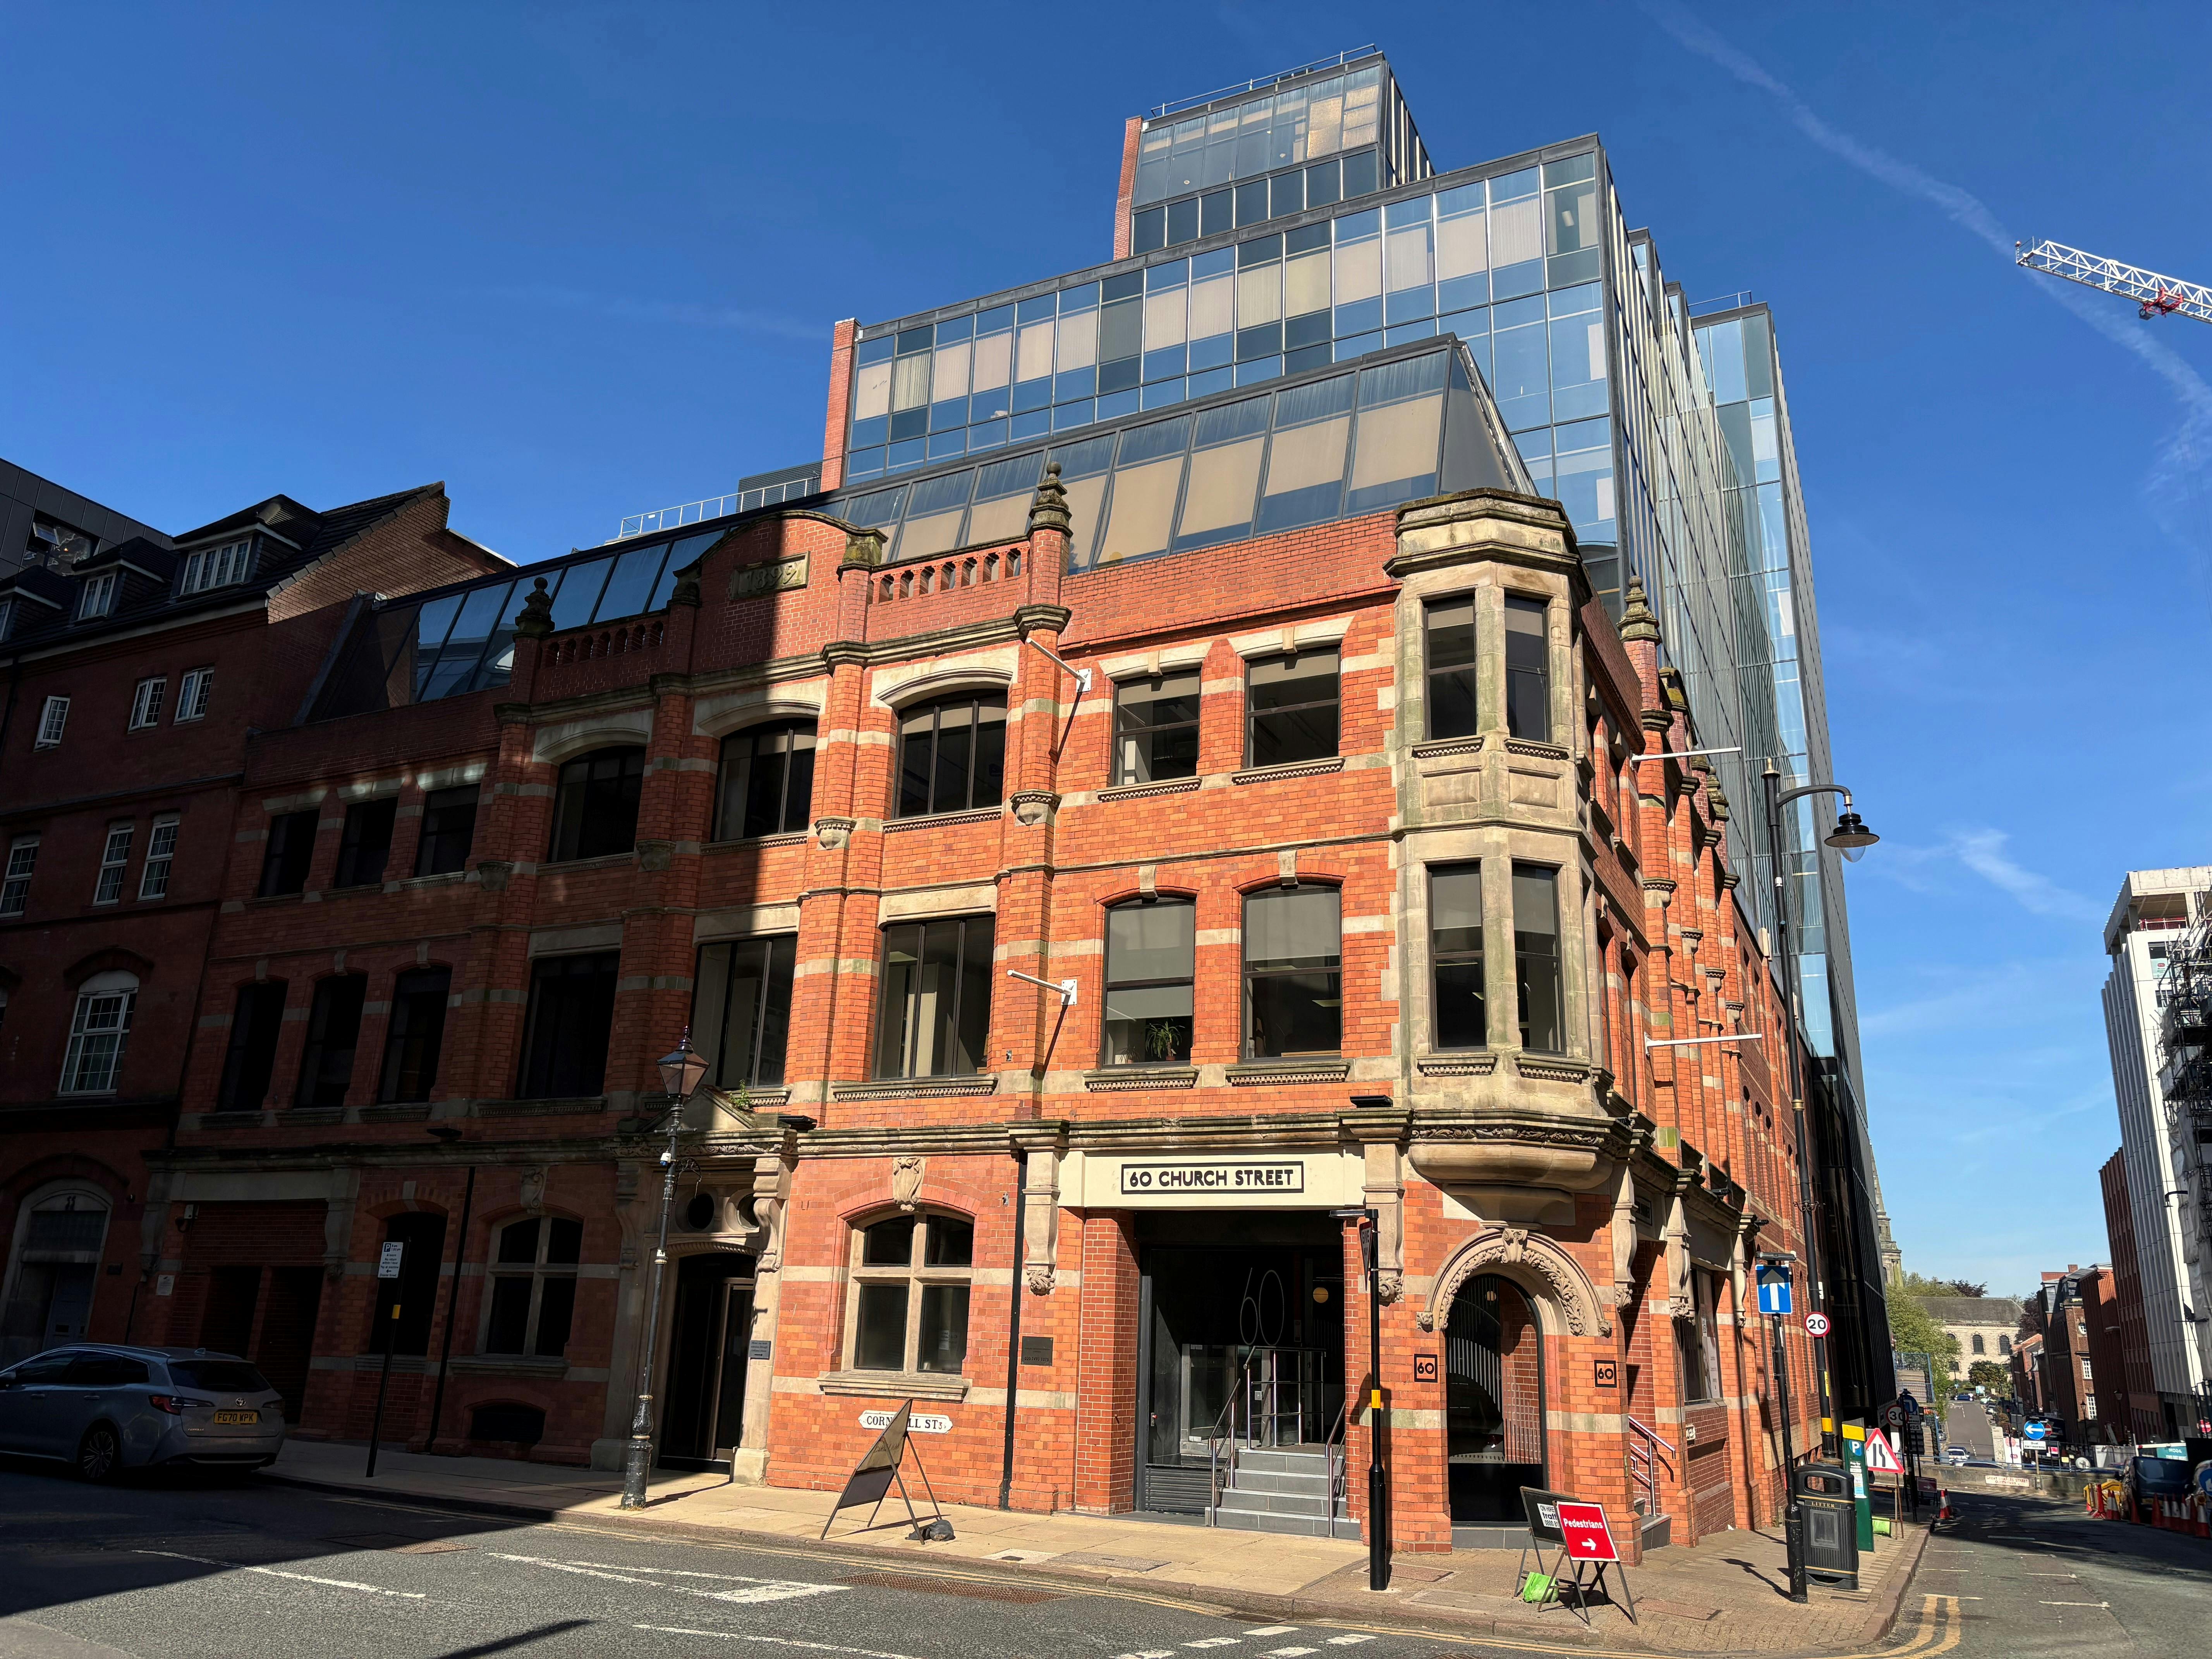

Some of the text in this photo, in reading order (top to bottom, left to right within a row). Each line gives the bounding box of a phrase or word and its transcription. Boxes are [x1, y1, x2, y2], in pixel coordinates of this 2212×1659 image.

[1129, 1169, 1293, 1187] 60 CHURCH STREET
[1240, 1267, 1284, 1346] 60
[1808, 1319, 1827, 1330] 20
[1417, 1362, 1434, 1374] 60
[1598, 1368, 1614, 1380] 60
[218, 1413, 237, 1421] FG70
[867, 1415, 921, 1428] CORNLL
[925, 1419, 938, 1429] ST
[1851, 1441, 1860, 1453] P
[1563, 1518, 1603, 1529] Pedestrians
